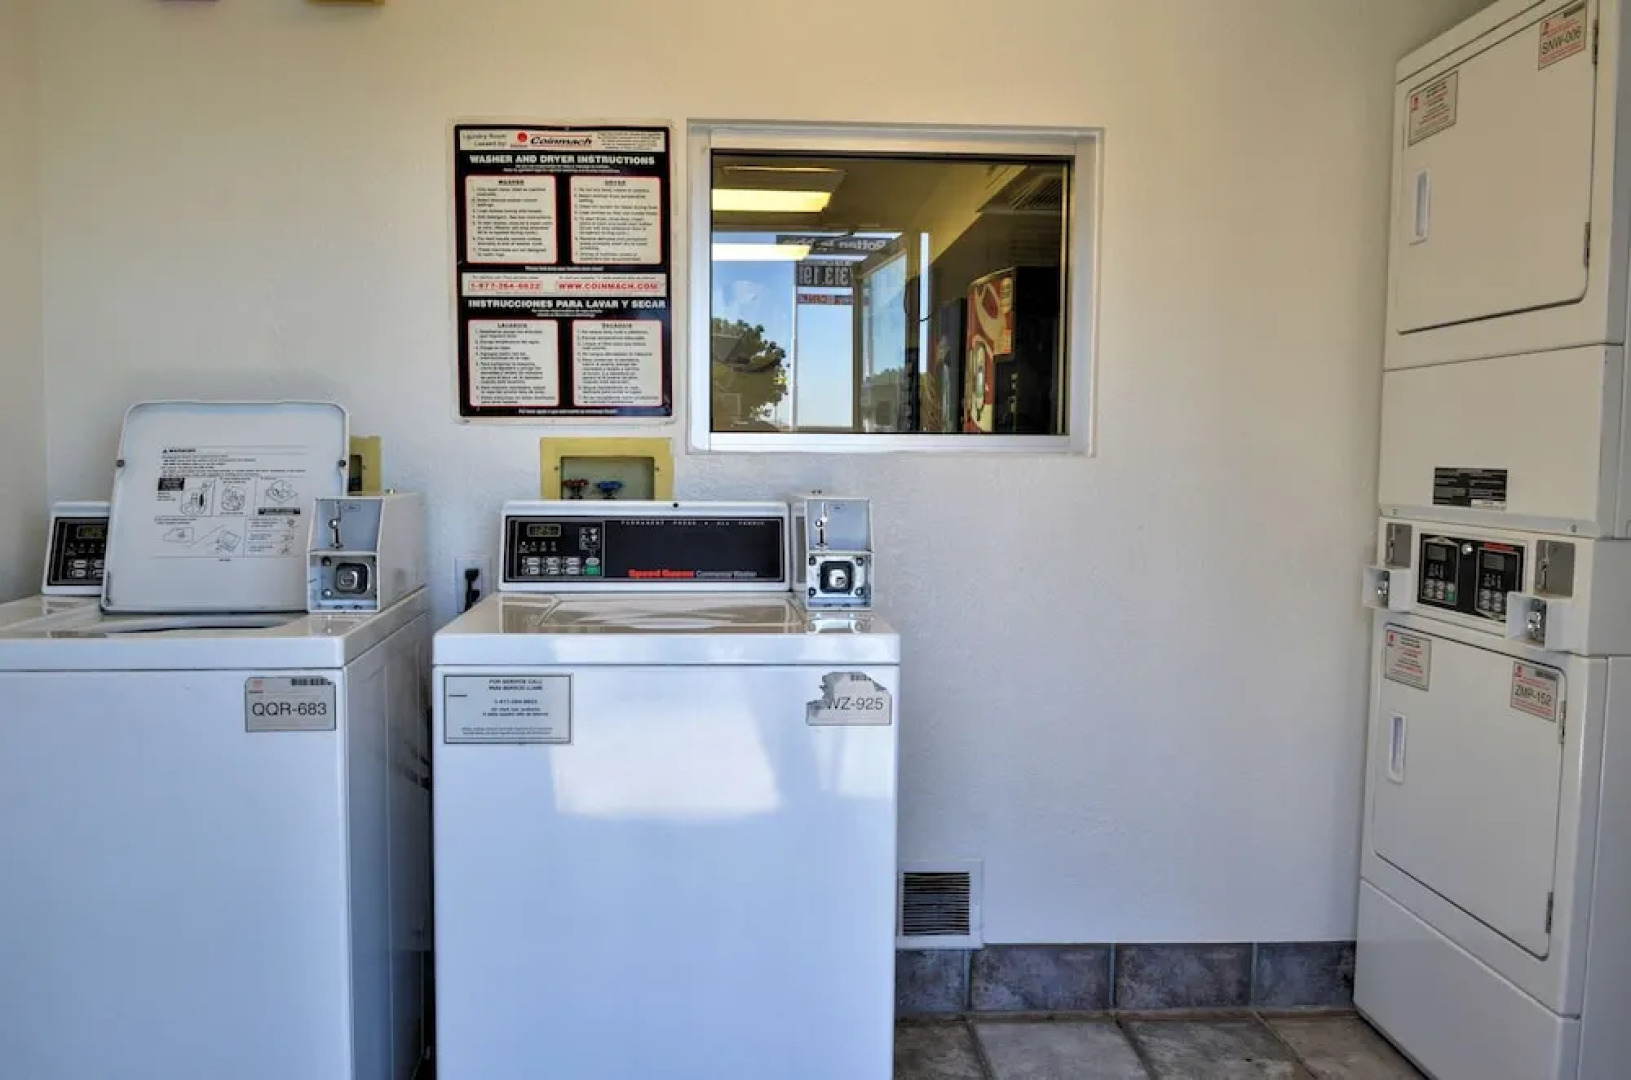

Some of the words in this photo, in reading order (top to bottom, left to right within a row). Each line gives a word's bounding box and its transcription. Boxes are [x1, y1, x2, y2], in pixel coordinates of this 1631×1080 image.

[530, 136, 592, 146] Coinmach
[470, 154, 513, 164] WASHER
[515, 155, 537, 164] AND
[539, 155, 575, 165] DRYER
[577, 155, 655, 166] INSTRUCTIONS
[558, 283, 659, 291] WWW.COINMACH.COM
[468, 299, 554, 309] INSTRUCCIONES
[556, 300, 584, 309] PARA
[586, 300, 619, 309] LAVAR
[622, 300, 630, 309] Y
[632, 300, 667, 309] SECAR
[1514, 683, 1552, 707] ZMP-152
[252, 702, 328, 717] QQR-683
